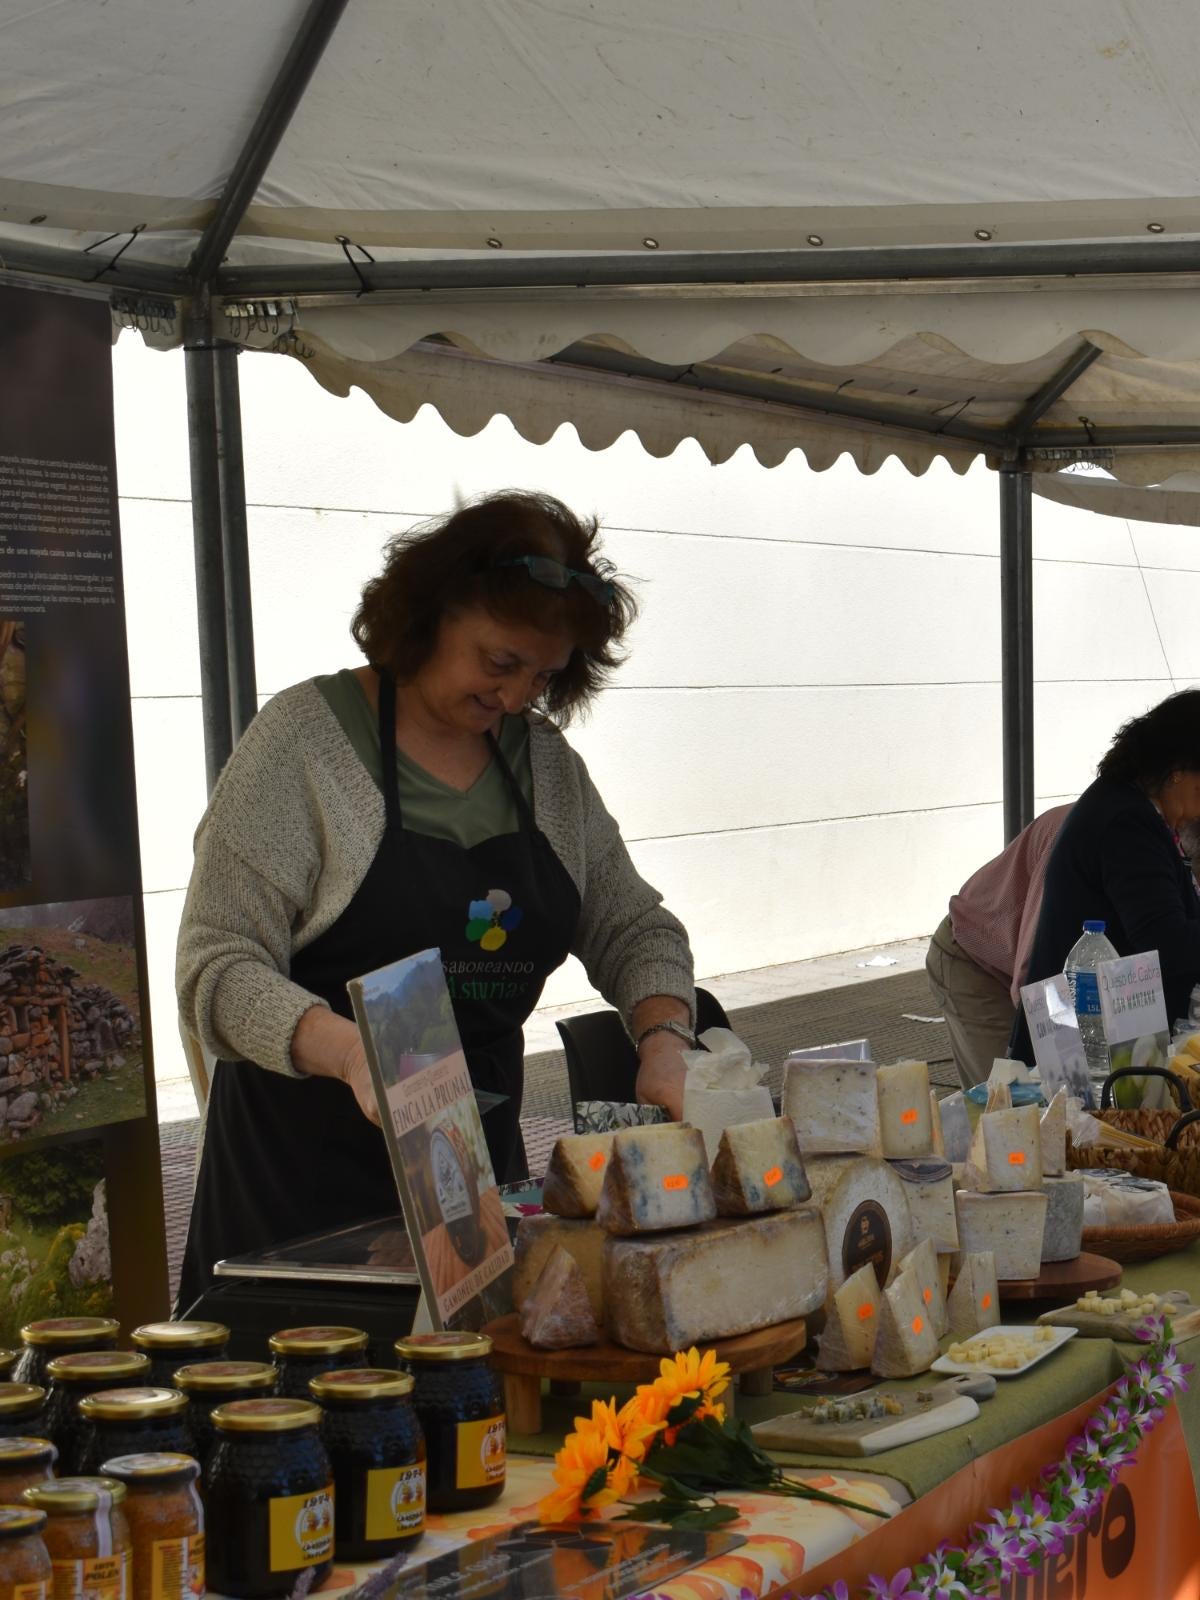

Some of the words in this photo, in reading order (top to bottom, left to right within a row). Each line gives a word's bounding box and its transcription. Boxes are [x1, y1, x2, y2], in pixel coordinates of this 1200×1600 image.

[392, 1100, 423, 1135] FINCA
[421, 1095, 437, 1116] LA
[434, 1072, 472, 1109] PRUNAL
